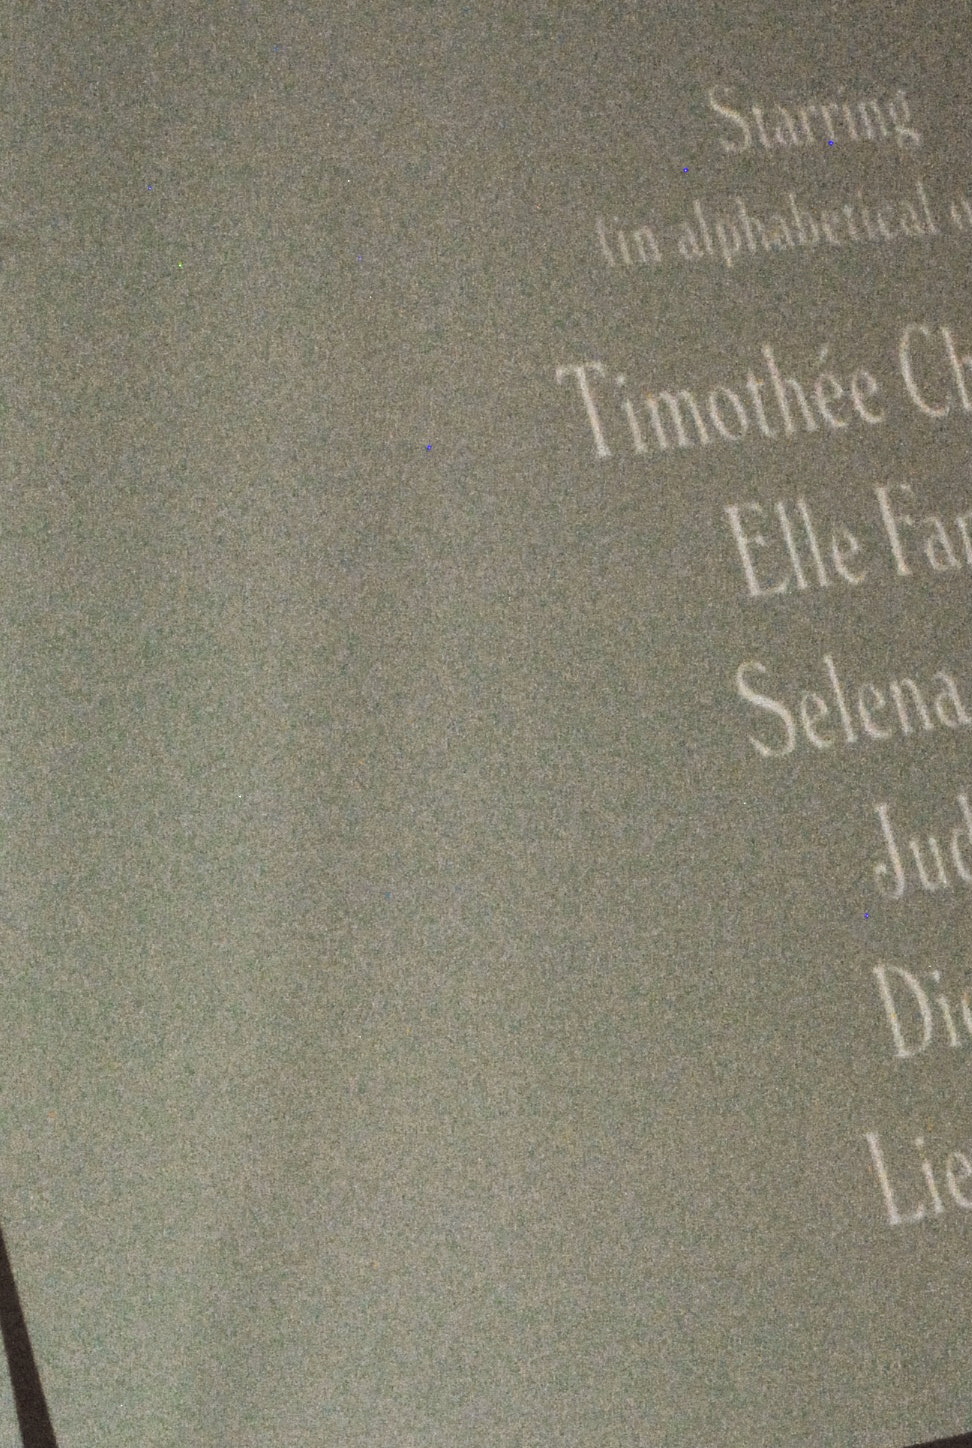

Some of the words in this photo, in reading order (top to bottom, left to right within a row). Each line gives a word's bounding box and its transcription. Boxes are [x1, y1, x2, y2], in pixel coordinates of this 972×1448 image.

[706, 84, 922, 156] Starring
[597, 214, 663, 268] (in
[677, 176, 939, 268] alphabetical
[556, 342, 884, 460] Timothée
[723, 497, 867, 599] Elle
[735, 653, 972, 758] Selena
